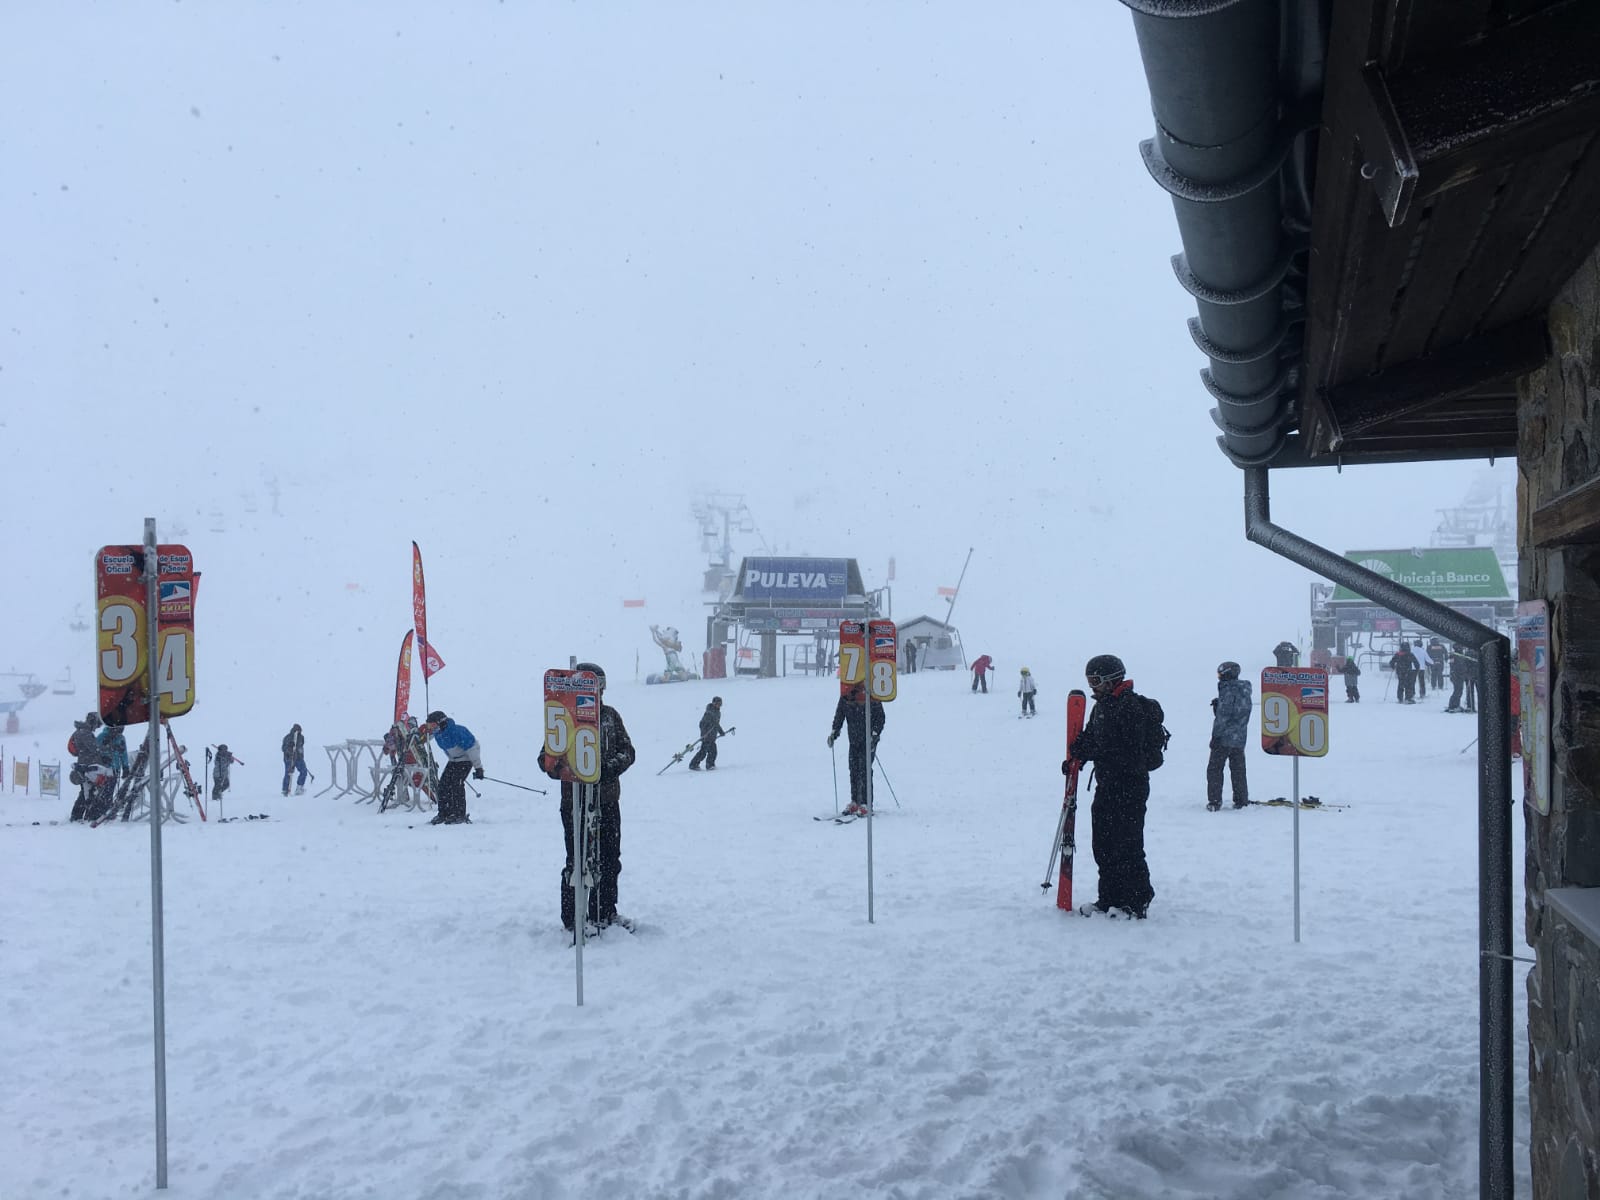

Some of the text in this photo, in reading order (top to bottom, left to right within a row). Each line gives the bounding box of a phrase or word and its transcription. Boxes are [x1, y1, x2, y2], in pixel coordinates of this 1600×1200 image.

[103, 555, 134, 563] Escuela
[106, 565, 131, 573] Oficial
[745, 570, 828, 588] PULEVA
[1390, 571, 1490, 585] Unicaja Banco
[101, 604, 137, 681] 3
[158, 633, 190, 704] 4
[842, 647, 860, 681] 7
[872, 662, 894, 697] 8
[1264, 671, 1326, 680] Escuela Oficial
[546, 706, 568, 754] 5
[1263, 696, 1290, 734] 9
[1299, 714, 1325, 752] 0
[575, 728, 597, 778] 6
